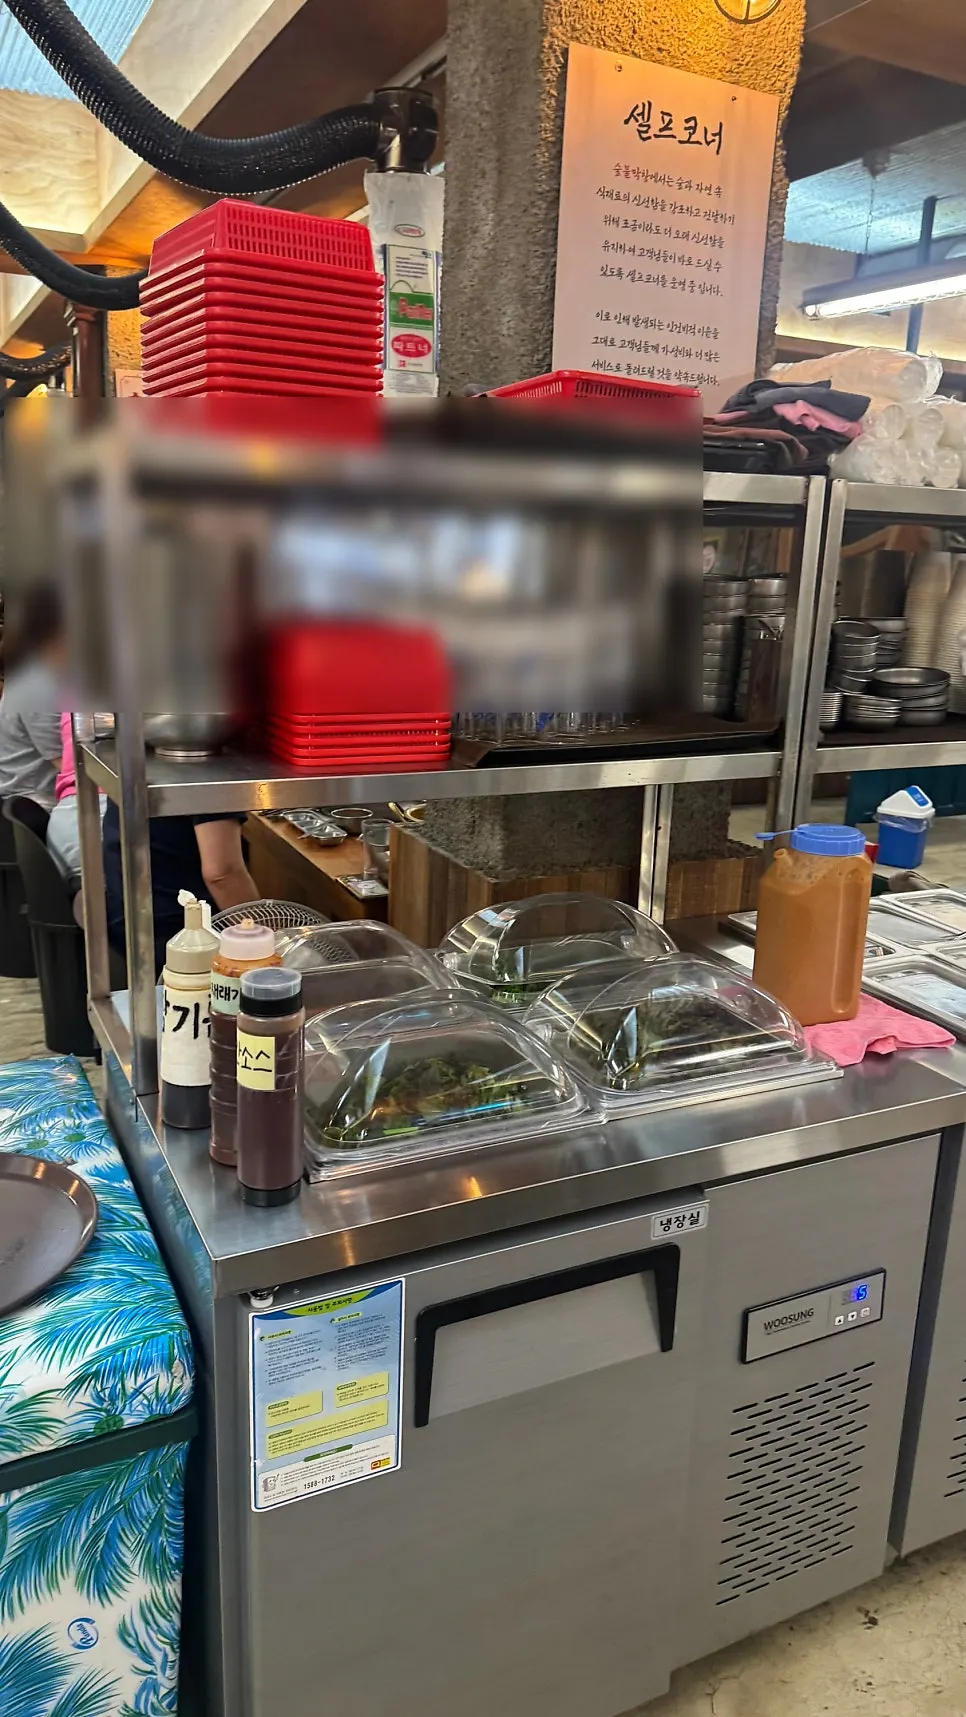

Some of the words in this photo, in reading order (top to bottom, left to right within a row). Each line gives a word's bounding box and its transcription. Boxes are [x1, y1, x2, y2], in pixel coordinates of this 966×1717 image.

[623, 99, 723, 155] 셀프코너
[595, 185, 630, 203] 식재료의
[631, 194, 667, 212] 신선함을
[668, 201, 701, 217] 강조하고
[702, 209, 734, 225] 전달하기
[621, 218, 662, 234] 조금이라도
[663, 226, 671, 238] 더
[672, 229, 690, 241] 오래
[690, 231, 724, 248] 신선함을
[601, 239, 635, 256] 유지하여
[636, 247, 676, 263] 고객님들이
[677, 254, 694, 265] 바로
[694, 258, 712, 271] 드실
[713, 260, 722, 272] 수
[599, 263, 624, 280] 있도록
[687, 280, 696, 293] 중
[595, 309, 611, 321] 이로
[591, 335, 616, 346] 그대로
[617, 338, 659, 354] 고객님들께
[695, 349, 702, 360] 더
[703, 349, 720, 362] 많은
[591, 358, 623, 372] 서비스로
[656, 367, 672, 380] 것을
[238, 1041, 272, 1072] 소스
[660, 1211, 700, 1231] 냉장실
[763, 1308, 814, 1330] WOOSUNG
